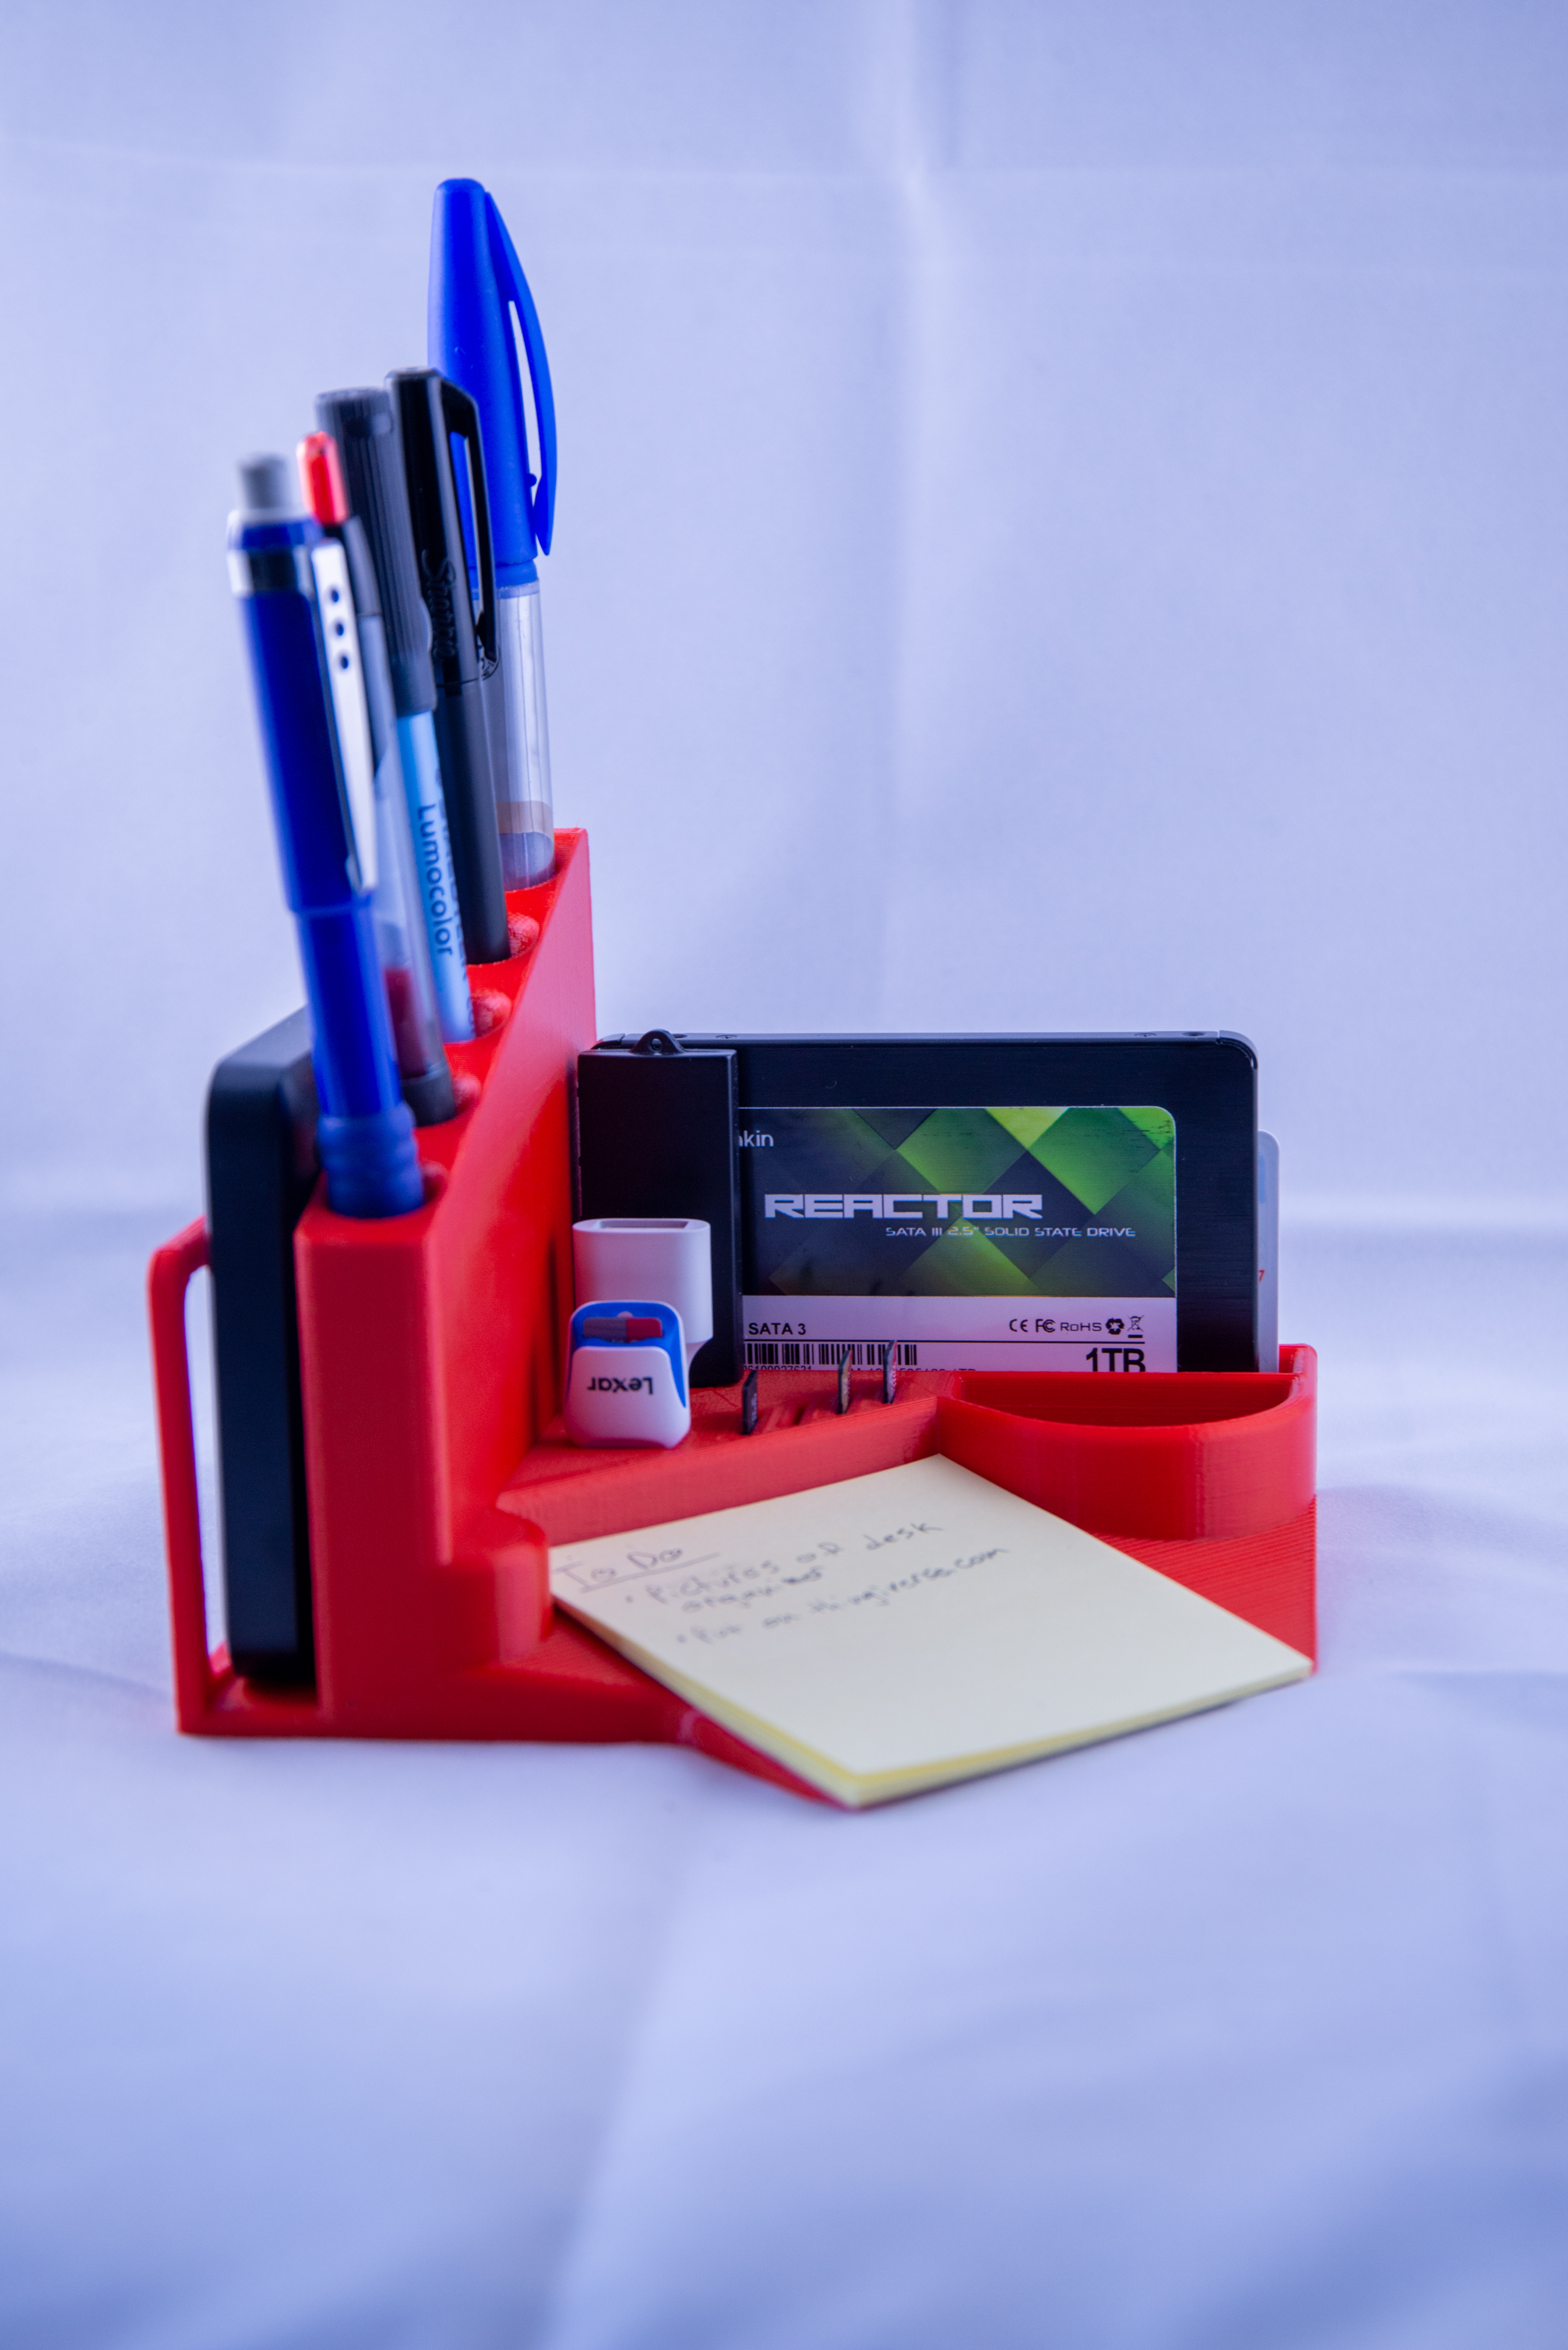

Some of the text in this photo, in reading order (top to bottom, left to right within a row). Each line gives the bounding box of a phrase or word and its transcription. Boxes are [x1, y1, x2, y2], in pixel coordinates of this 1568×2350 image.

[418, 804, 453, 956] Lumocolor
[764, 1194, 1043, 1219] REACTOR
[886, 1226, 1136, 1237] SATA III 2.5" SOLID STATE DRIVE
[748, 1322, 806, 1335] SATA 3
[1060, 1322, 1102, 1332] RoHS
[1086, 1347, 1146, 1372] 1TB
[587, 1377, 653, 1395] Lexar
[863, 1517, 945, 1551] desk
[549, 1547, 683, 1588] To Do
